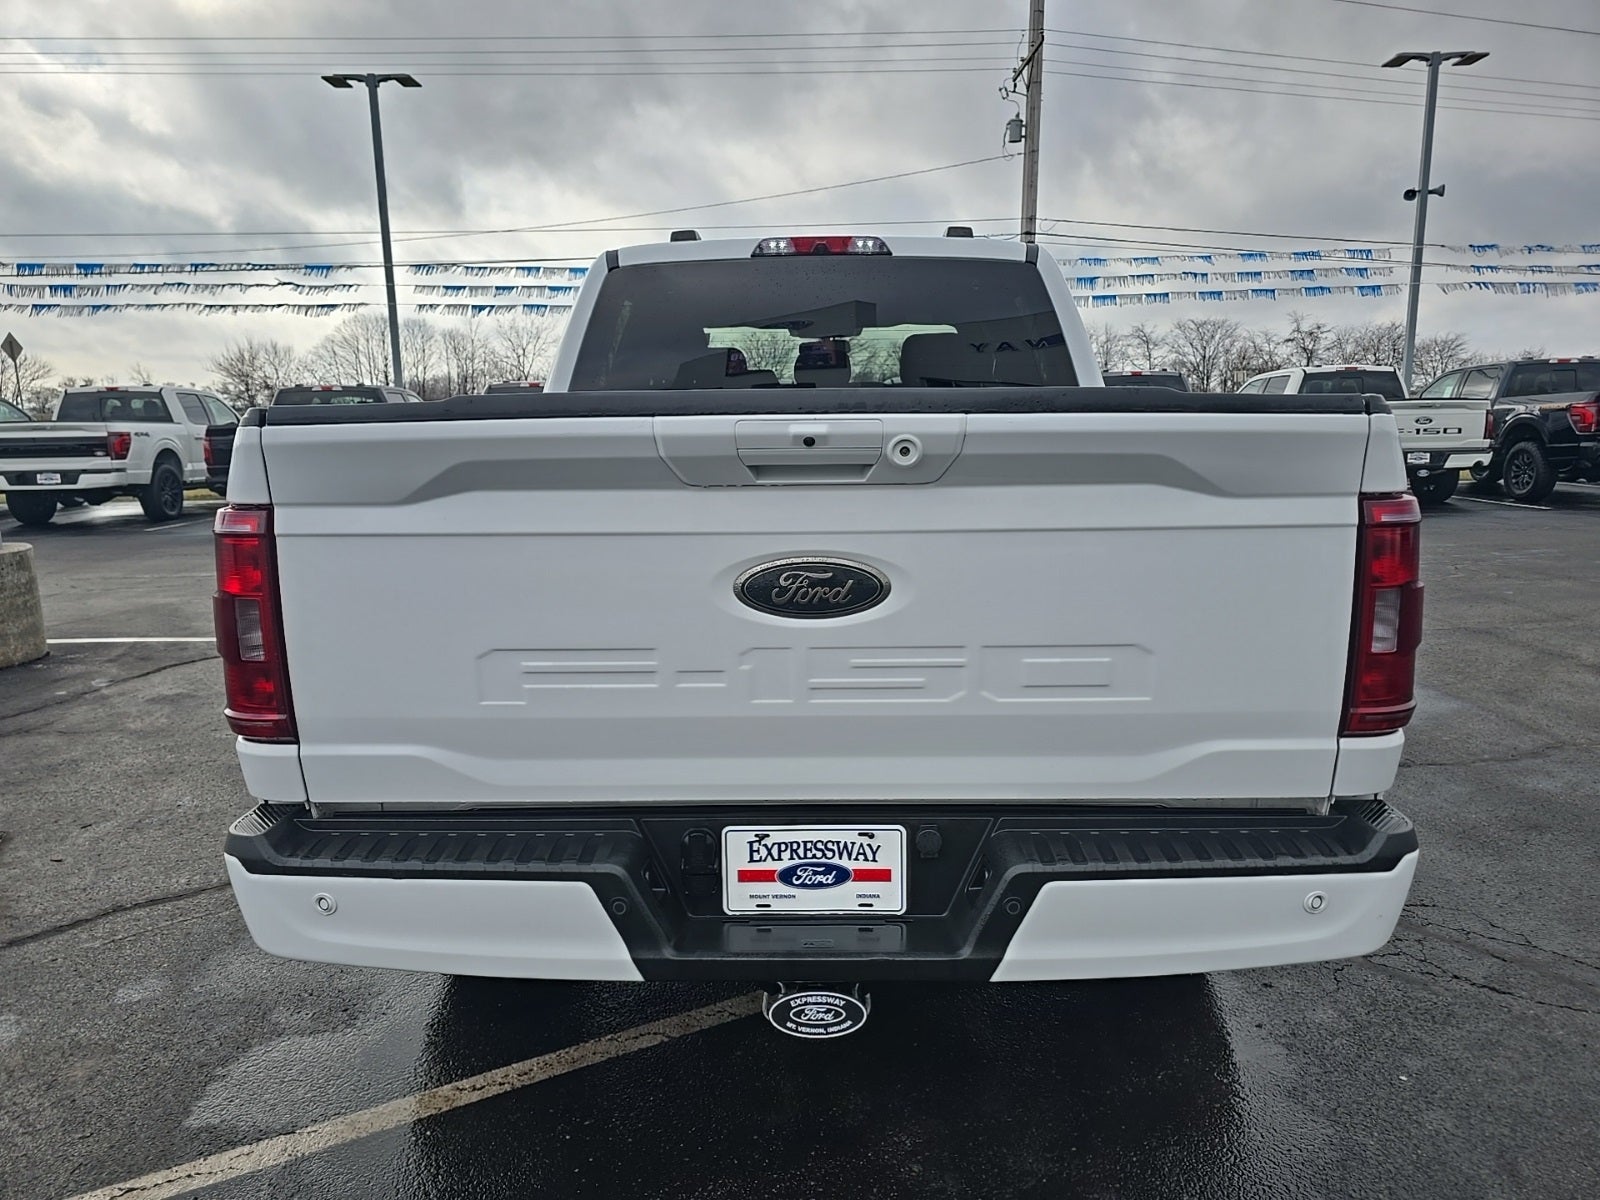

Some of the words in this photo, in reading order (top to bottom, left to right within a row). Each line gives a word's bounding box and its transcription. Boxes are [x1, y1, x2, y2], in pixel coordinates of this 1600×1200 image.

[771, 571, 854, 605] Ford
[477, 643, 1154, 706] F-150
[747, 840, 881, 863] EXPRESSWAY
[792, 866, 836, 885] Ford
[789, 996, 846, 1007] EXPRESSWAY
[801, 1007, 835, 1020] Ford
[827, 1020, 853, 1032] INDIANA
